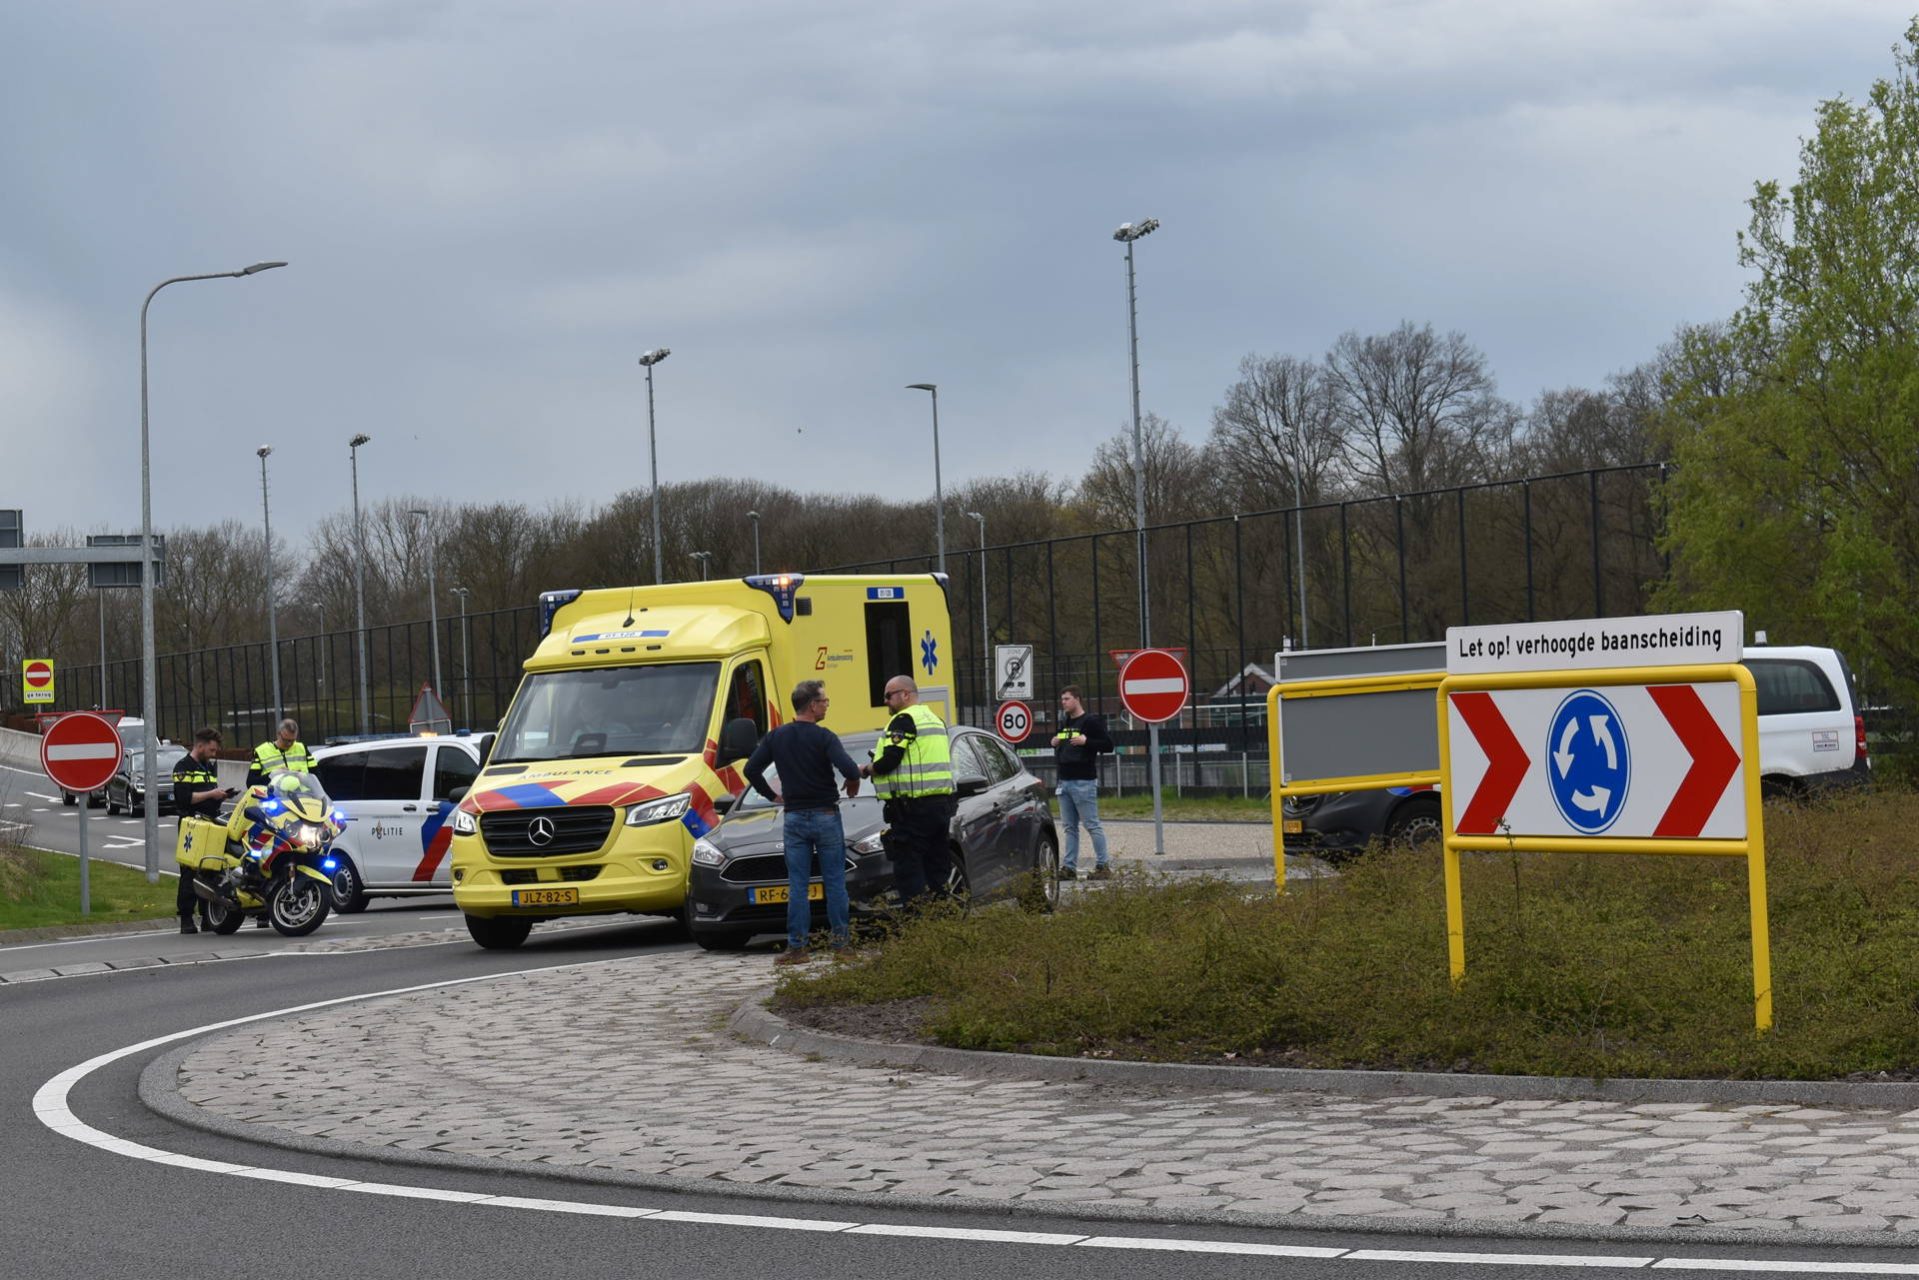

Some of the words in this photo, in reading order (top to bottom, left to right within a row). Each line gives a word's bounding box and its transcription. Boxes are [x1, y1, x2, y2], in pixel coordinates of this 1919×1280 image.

[1459, 638, 1483, 658] Let
[1488, 635, 1511, 660] op!
[1516, 632, 1595, 658] verhoogde
[1601, 626, 1722, 652] baanscheiding
[1003, 713, 1027, 730] 80
[518, 769, 614, 780] AMBULANCE
[371, 826, 403, 839] POLITIE
[524, 891, 572, 904] JLZ-82-S
